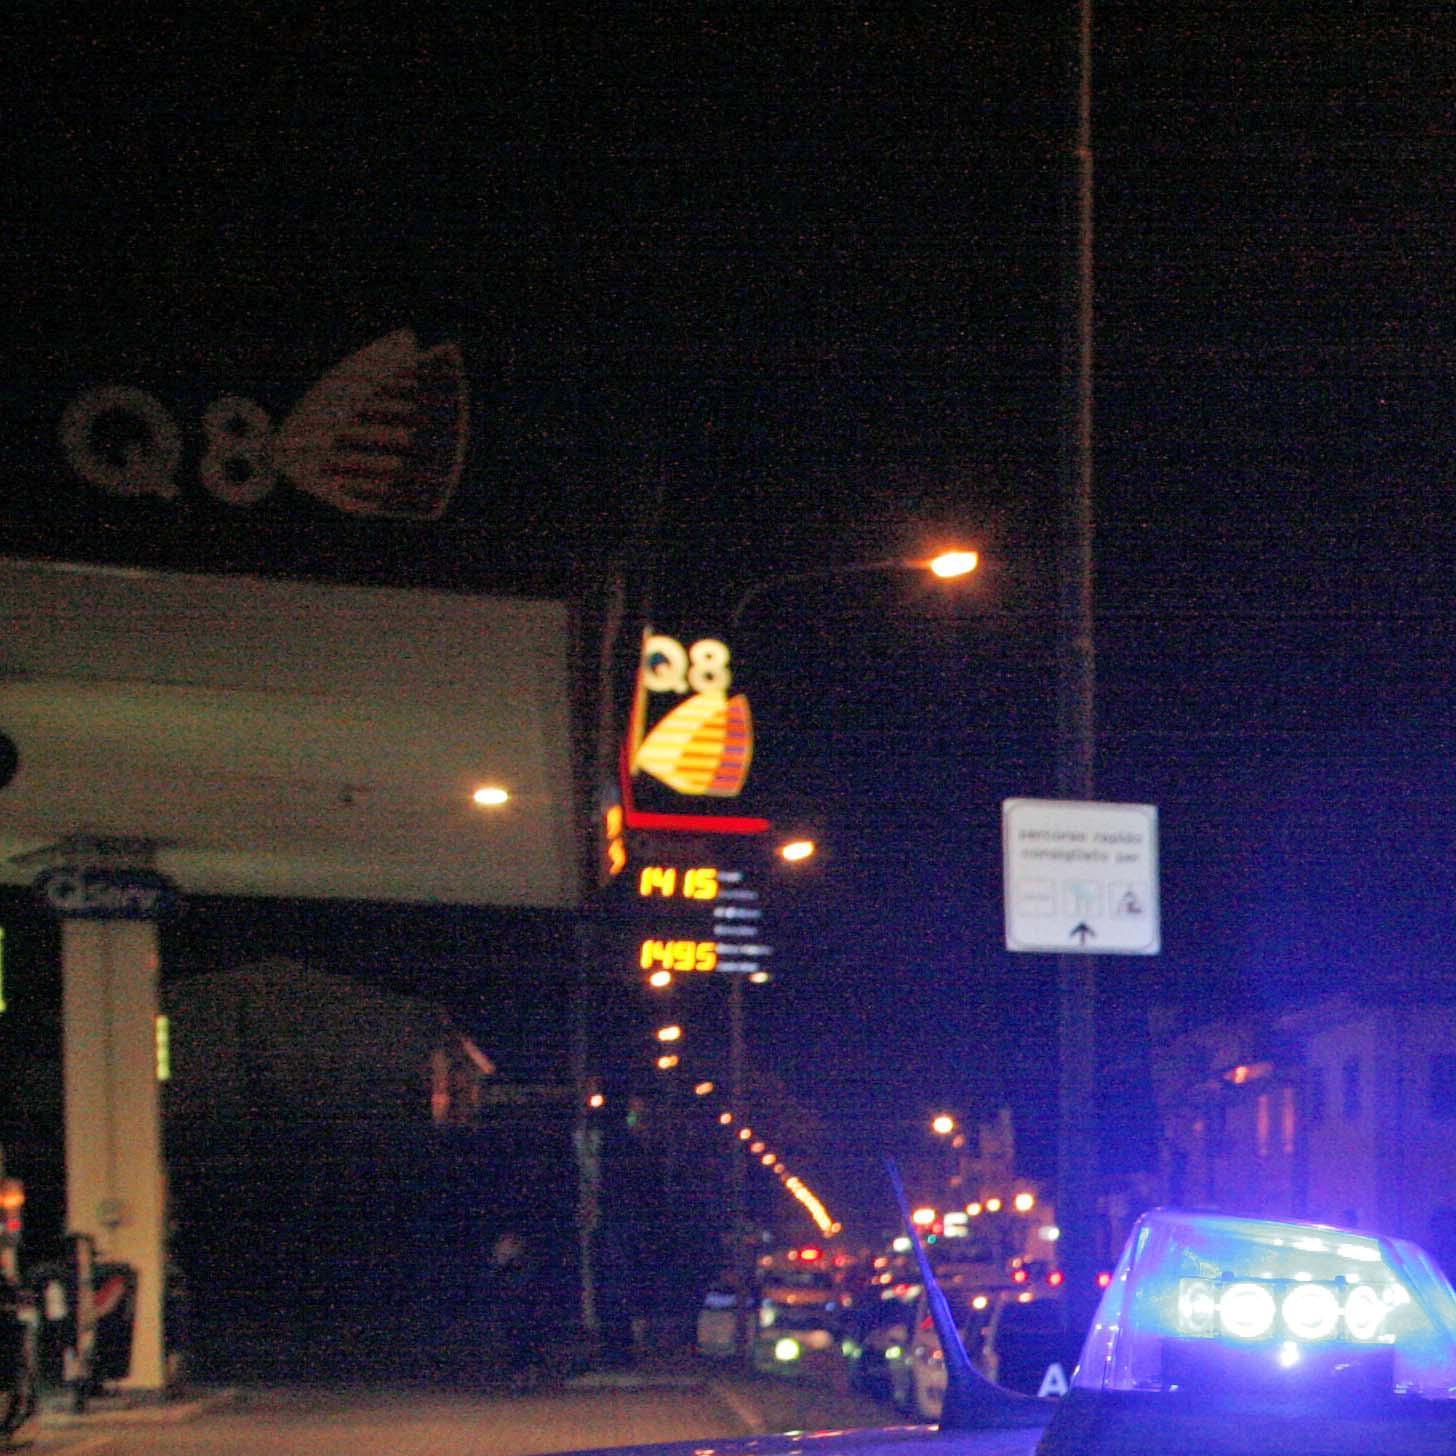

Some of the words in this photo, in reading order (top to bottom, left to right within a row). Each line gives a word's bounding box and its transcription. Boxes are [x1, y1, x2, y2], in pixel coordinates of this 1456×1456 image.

[60, 384, 278, 506] Q8
[644, 634, 732, 694] Q8
[640, 939, 718, 972] 1495
[1038, 1362, 1069, 1397] A
